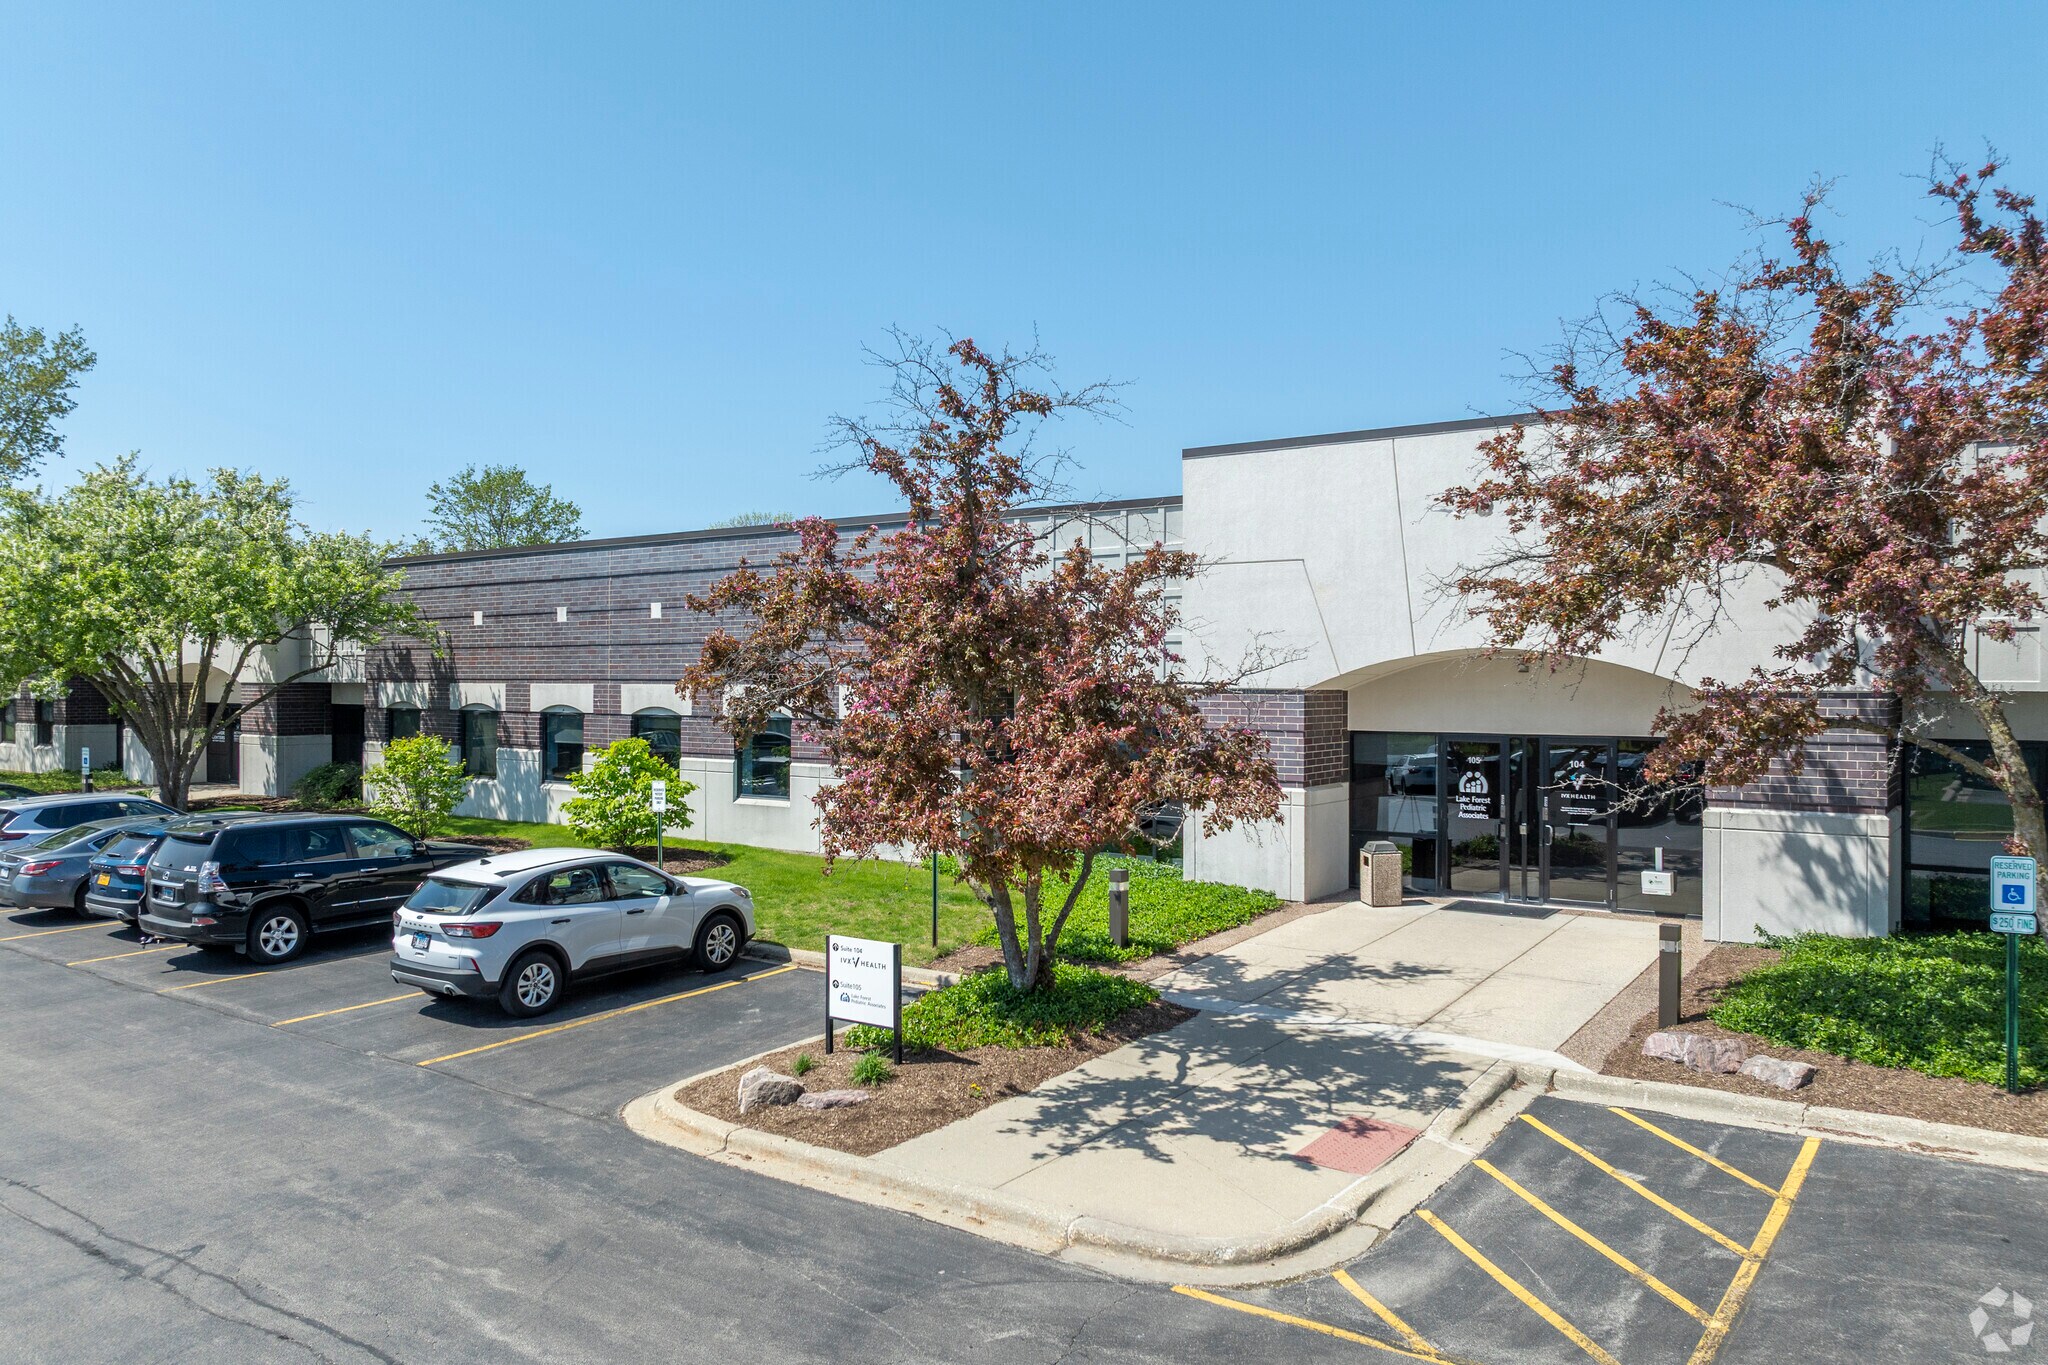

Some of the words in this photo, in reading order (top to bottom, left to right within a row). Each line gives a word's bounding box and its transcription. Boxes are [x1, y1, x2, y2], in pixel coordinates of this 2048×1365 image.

[1570, 760, 1585, 768] 104
[1472, 796, 1490, 804] Forest
[1460, 803, 1486, 812] Pediatric
[1458, 812, 1489, 820] Associates
[1994, 862, 2032, 870] RESERVED
[1997, 871, 2030, 880] PARKING
[2017, 919, 2034, 930] FINE
[860, 961, 886, 970] HEALTH
